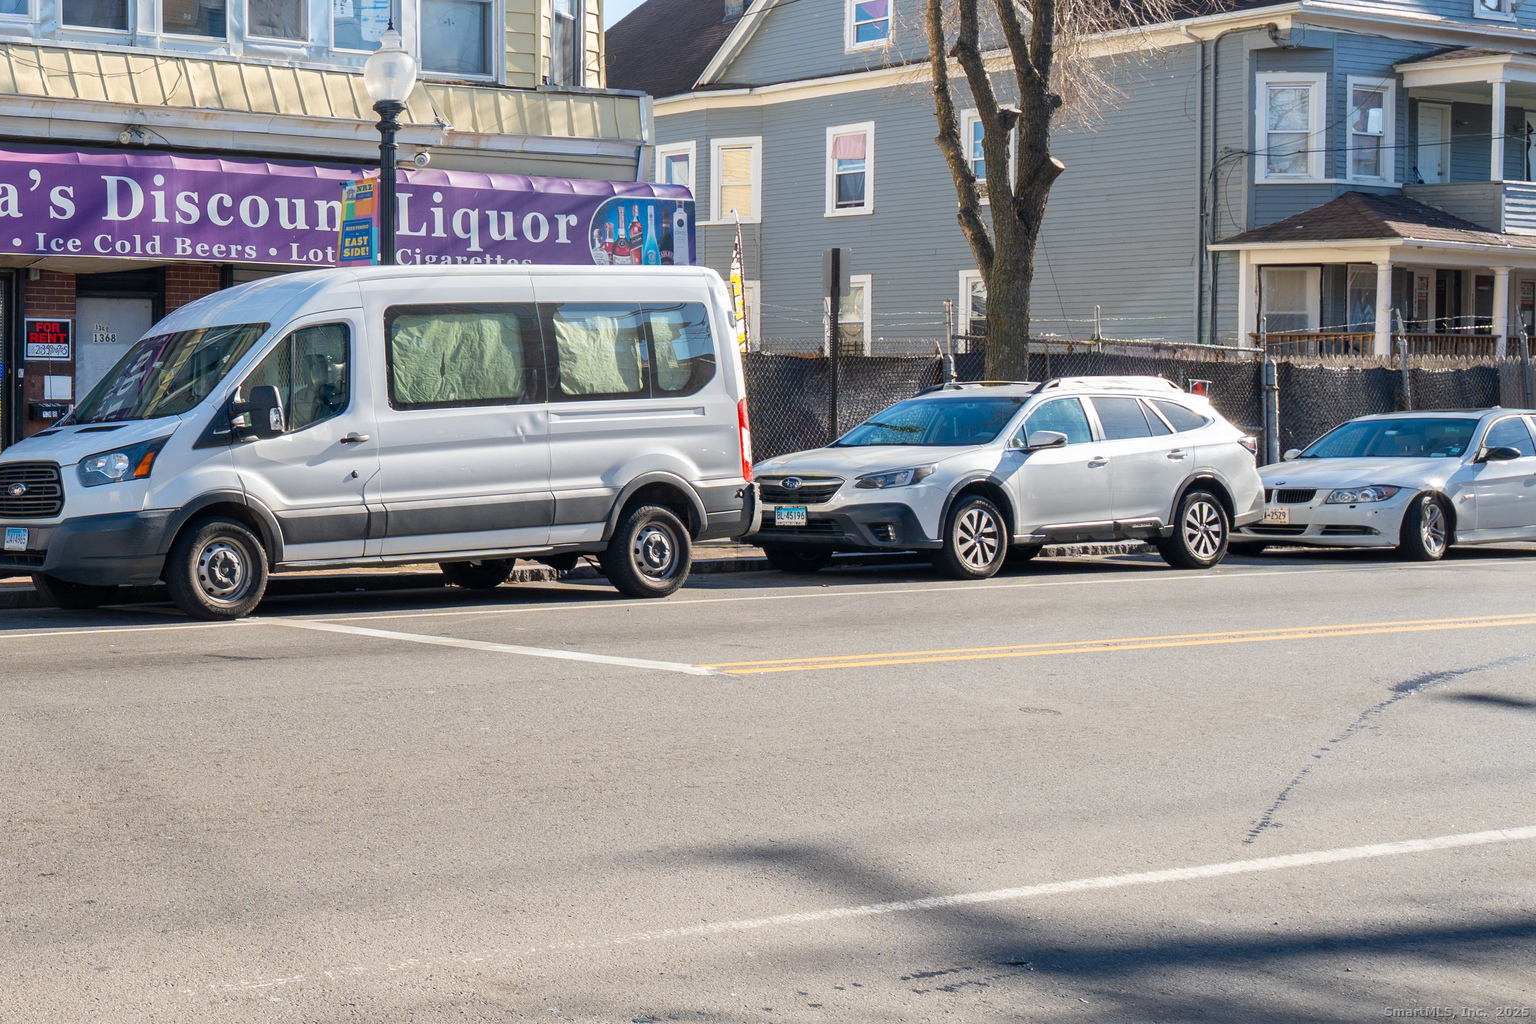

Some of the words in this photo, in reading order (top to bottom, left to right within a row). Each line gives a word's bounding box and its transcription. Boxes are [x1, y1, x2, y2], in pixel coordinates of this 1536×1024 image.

[356, 183, 373, 192] NRZ
[102, 174, 342, 232] Discoun
[396, 193, 578, 251] Liquor
[36, 232, 82, 252] Ice
[95, 233, 162, 256] Cold
[174, 236, 256, 258] Beers
[290, 241, 336, 262] Lot
[345, 236, 369, 247] EAST
[343, 246, 369, 257] SIDE!
[36, 322, 60, 333] FOR
[29, 333, 67, 343] RENT
[93, 333, 117, 343] 1368
